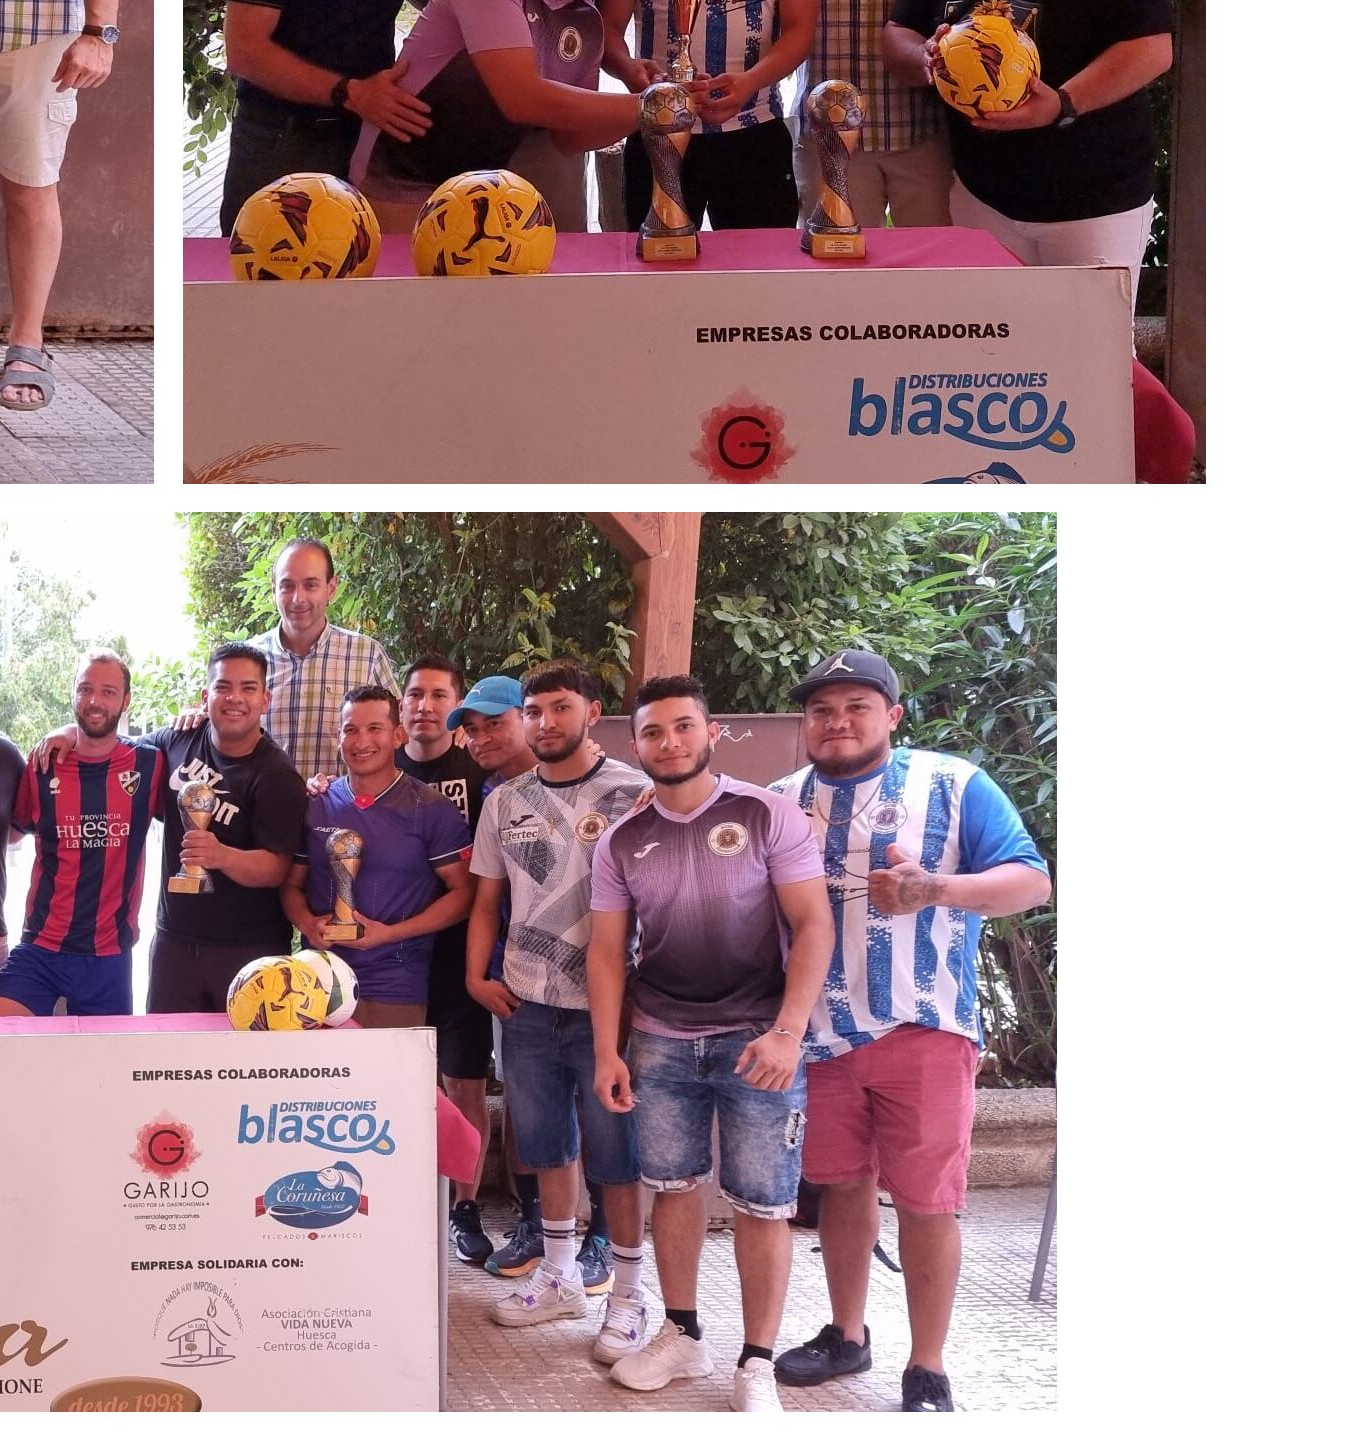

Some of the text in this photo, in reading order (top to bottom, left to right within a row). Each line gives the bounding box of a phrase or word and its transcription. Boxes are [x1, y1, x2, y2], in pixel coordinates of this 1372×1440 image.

[696, 323, 1010, 343] EMPRESAS COLABORADORAS
[908, 372, 1048, 390] DISTRIBUCIONES
[848, 376, 1049, 440] blasco
[132, 1067, 351, 1081] EMPRESAS COLABORADORAS
[279, 1100, 377, 1113] DISTRIBUCIONES
[237, 1104, 377, 1147] blasco
[123, 1180, 209, 1200] GARIJO
[288, 1178, 305, 1191] La
[276, 1185, 346, 1203] Coruñesa
[131, 1258, 304, 1271] EMPRESA SOLIDARIA CON:
[261, 1306, 372, 1319] Asociación Cristiana
[280, 1319, 353, 1330] VIDA NUEVA
[297, 1330, 337, 1341] Huesca
[263, 1340, 370, 1353] Centros de Acogida
[133, 1393, 184, 1412] 1993
